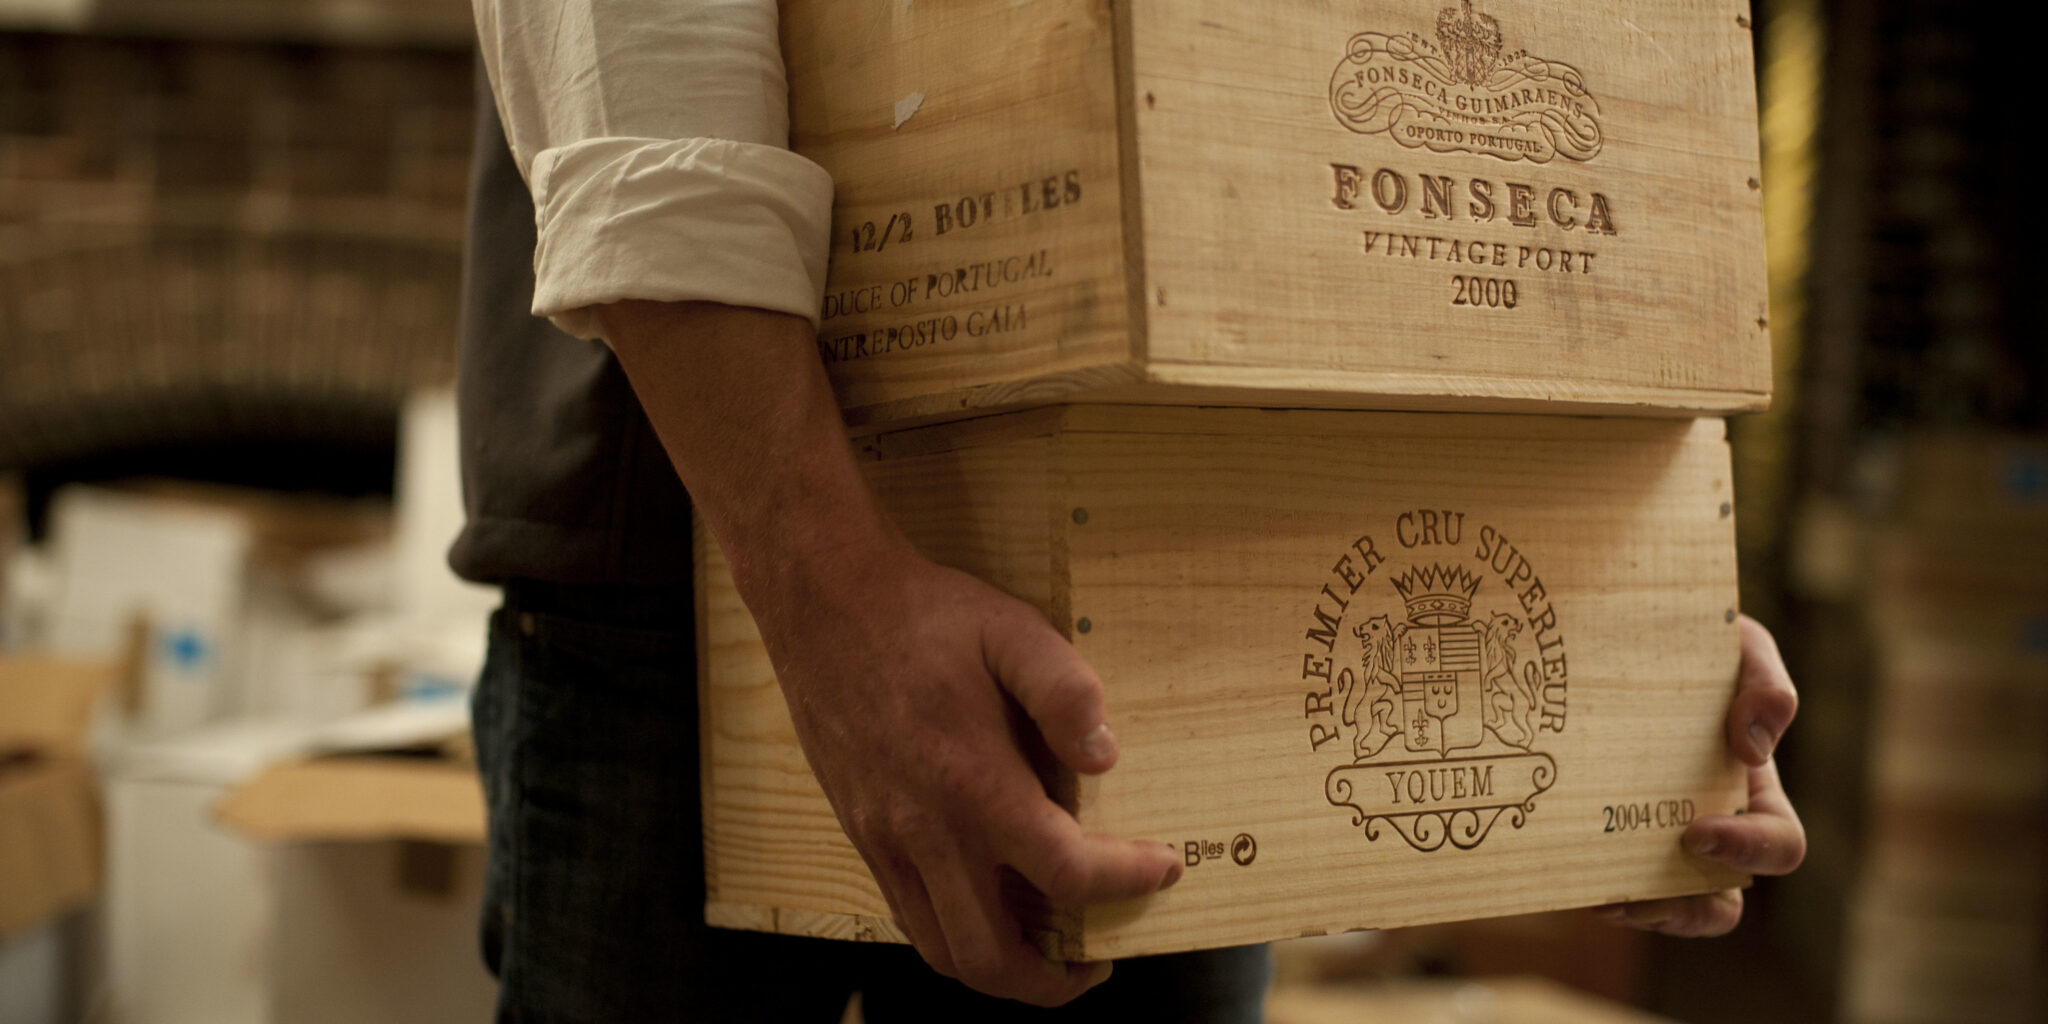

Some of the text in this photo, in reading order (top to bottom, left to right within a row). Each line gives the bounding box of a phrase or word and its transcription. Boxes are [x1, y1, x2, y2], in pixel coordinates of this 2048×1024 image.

[1353, 66, 1584, 119] FONSECA GUIMARAENS
[1406, 125, 1542, 153] OPORTO PORTUGAL
[1330, 163, 1617, 236] FONSECA
[851, 212, 913, 253] 12/2
[1363, 231, 1597, 274] VINTAGE PORT
[890, 277, 919, 308] OF
[924, 249, 1054, 300] PORTUGAL
[1451, 275, 1518, 309] 2000
[817, 303, 1027, 365] NTREPOSTO GAIA
[1303, 509, 1568, 752] PREMIER CRU SUPERIEUR
[1386, 765, 1494, 805] YQUEM
[1602, 798, 1695, 833] 2004 CRD
